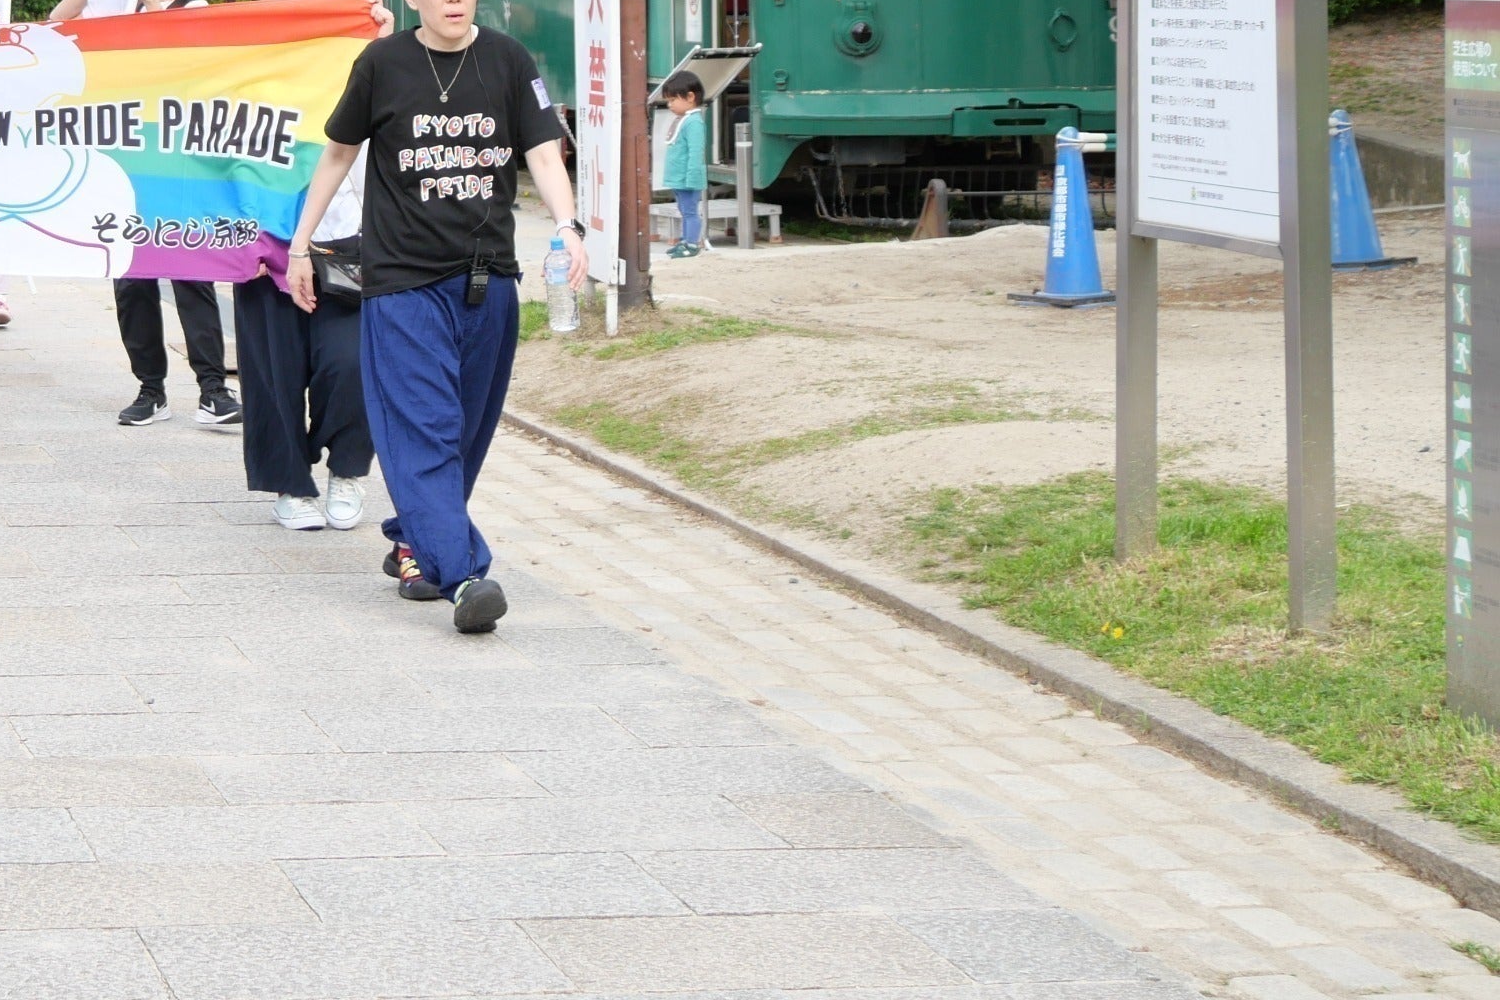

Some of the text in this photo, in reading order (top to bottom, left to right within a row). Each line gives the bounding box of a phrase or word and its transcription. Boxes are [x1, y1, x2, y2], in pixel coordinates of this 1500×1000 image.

[1452, 39, 1492, 58] 芝生広場の
[1452, 60, 1498, 78] 使用について
[35, 102, 141, 147] PRIDE
[162, 99, 299, 167] PARADE
[412, 112, 496, 139] KYOTO
[398, 145, 513, 173] RAINBOW
[419, 174, 494, 202] PRIDE
[92, 213, 260, 249] そらにじ京都
